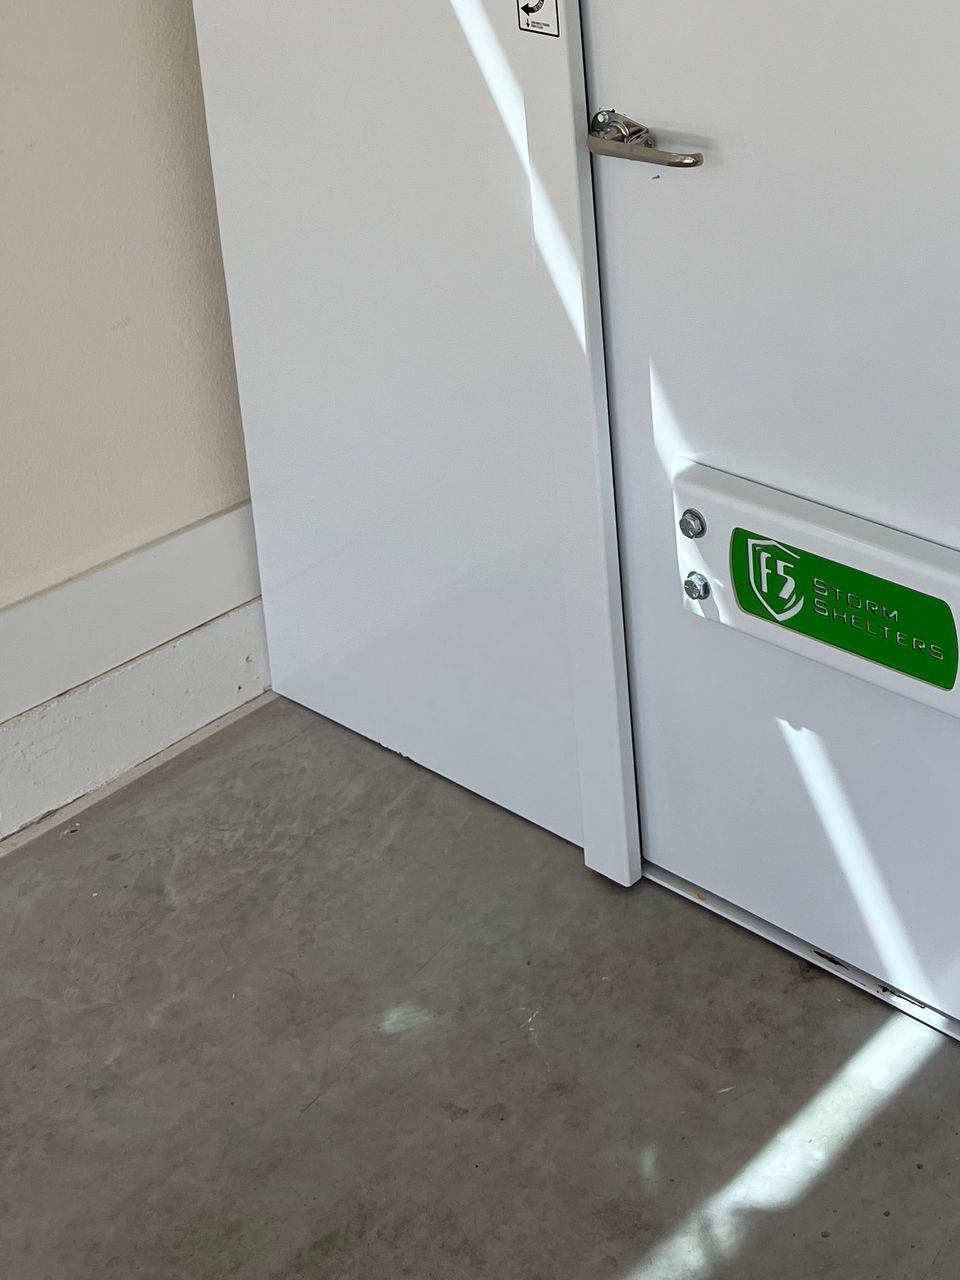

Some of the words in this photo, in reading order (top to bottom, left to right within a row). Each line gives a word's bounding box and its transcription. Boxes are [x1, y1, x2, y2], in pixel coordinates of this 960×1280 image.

[760, 551, 796, 600] F5
[812, 578, 898, 623] STORM
[812, 598, 944, 660] SHELTERS
